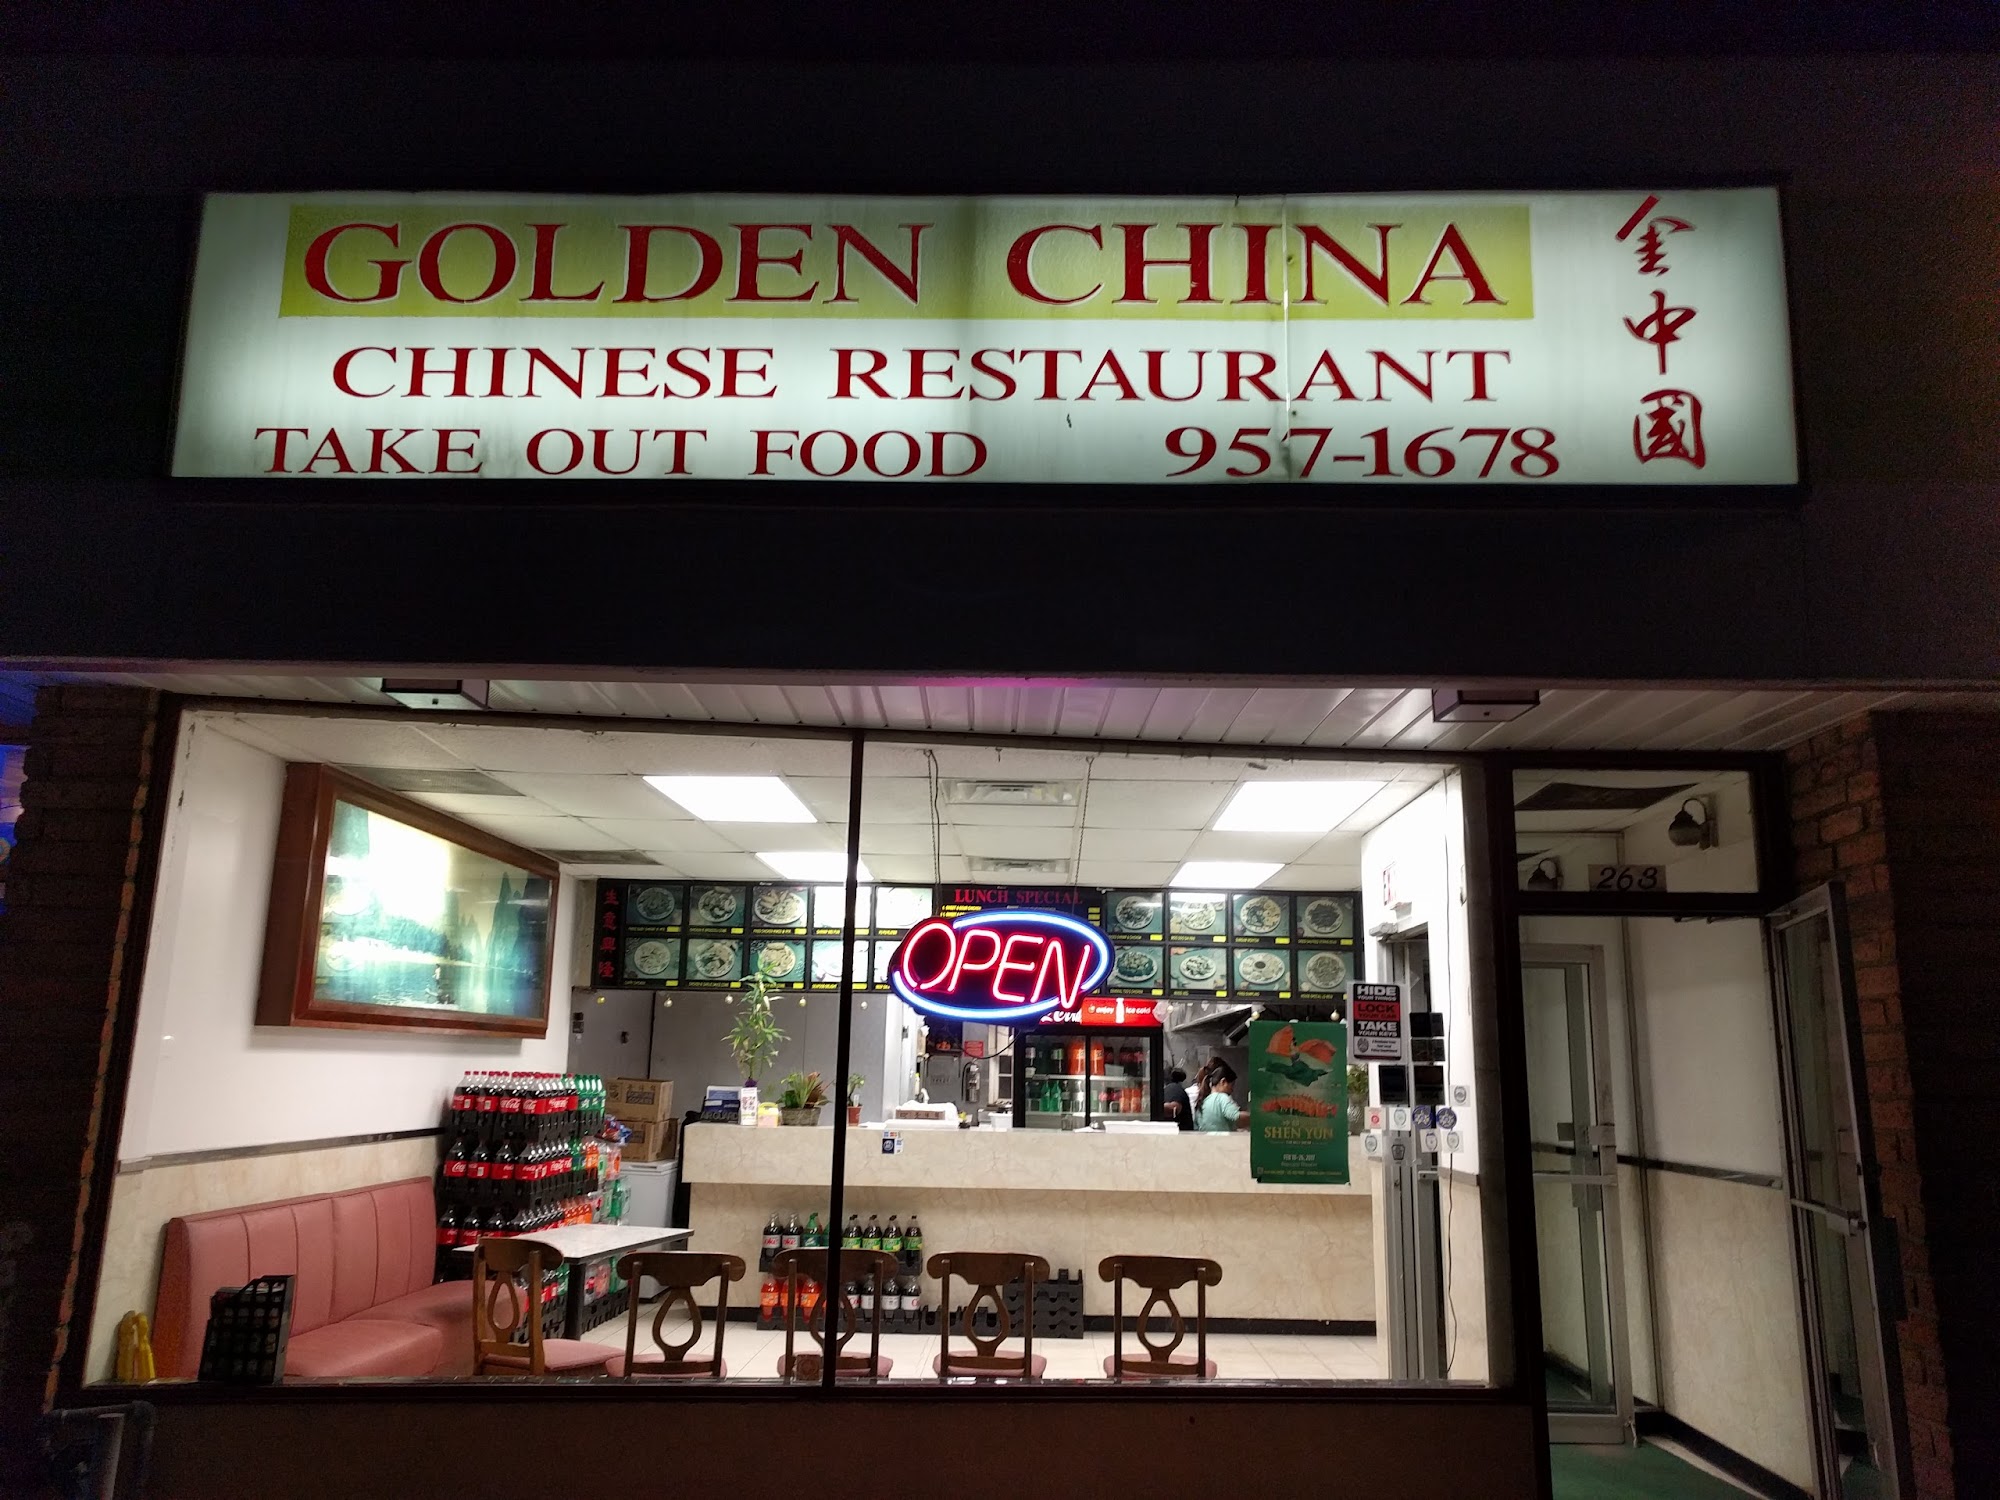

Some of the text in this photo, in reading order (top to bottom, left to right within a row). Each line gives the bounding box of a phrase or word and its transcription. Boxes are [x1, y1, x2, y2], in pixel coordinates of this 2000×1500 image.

[303, 222, 1510, 306] GOLDEN CHINA
[332, 347, 1512, 403] CHINESE RESTAURANT
[256, 426, 1560, 480] TAKE OUT FOOD 957-1678
[1596, 866, 1658, 892] 263
[954, 888, 1083, 905] LUNCH SPECIAL
[902, 921, 1091, 1009] OPEN
[1357, 985, 1396, 996] HIDE
[1095, 1007, 1115, 1015] enjoy
[1358, 1003, 1395, 1013] LOCK
[1357, 1021, 1397, 1031] TAKE
[1264, 1126, 1333, 1139] SHEN YUN
